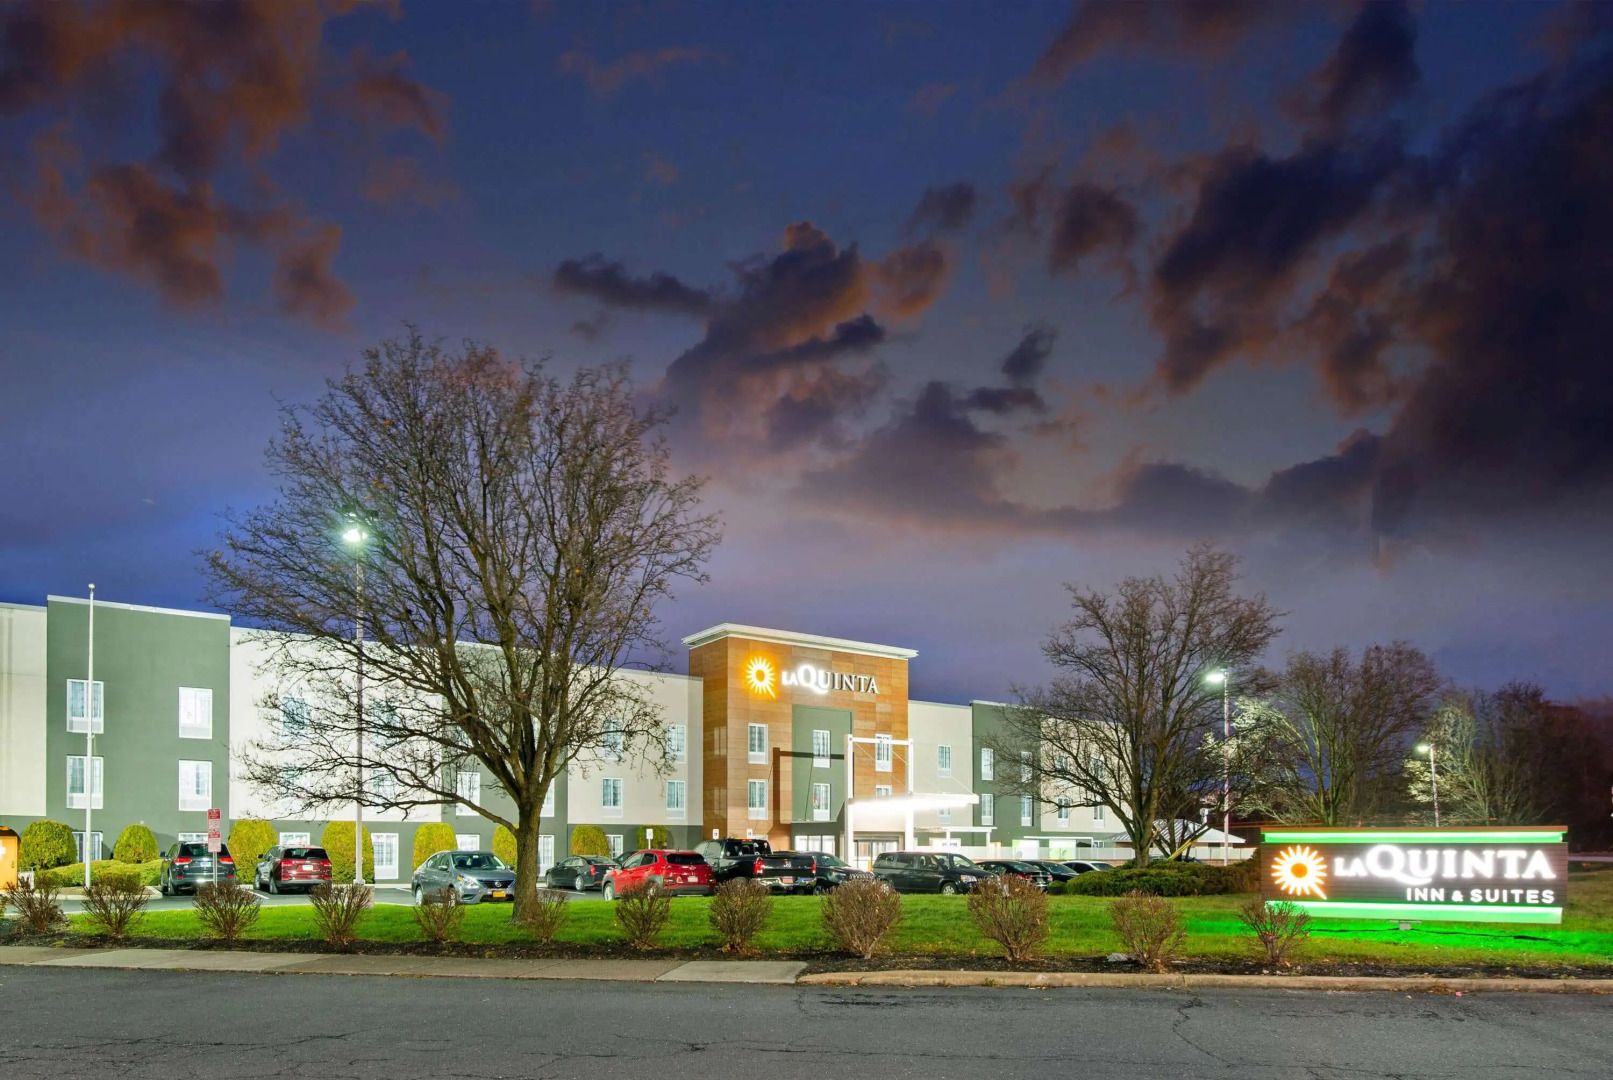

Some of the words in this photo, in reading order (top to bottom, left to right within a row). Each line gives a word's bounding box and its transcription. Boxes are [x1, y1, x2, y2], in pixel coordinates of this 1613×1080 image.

[1406, 887, 1445, 902] INN
[1451, 890, 1463, 903] &
[1470, 888, 1555, 904] SUITES
